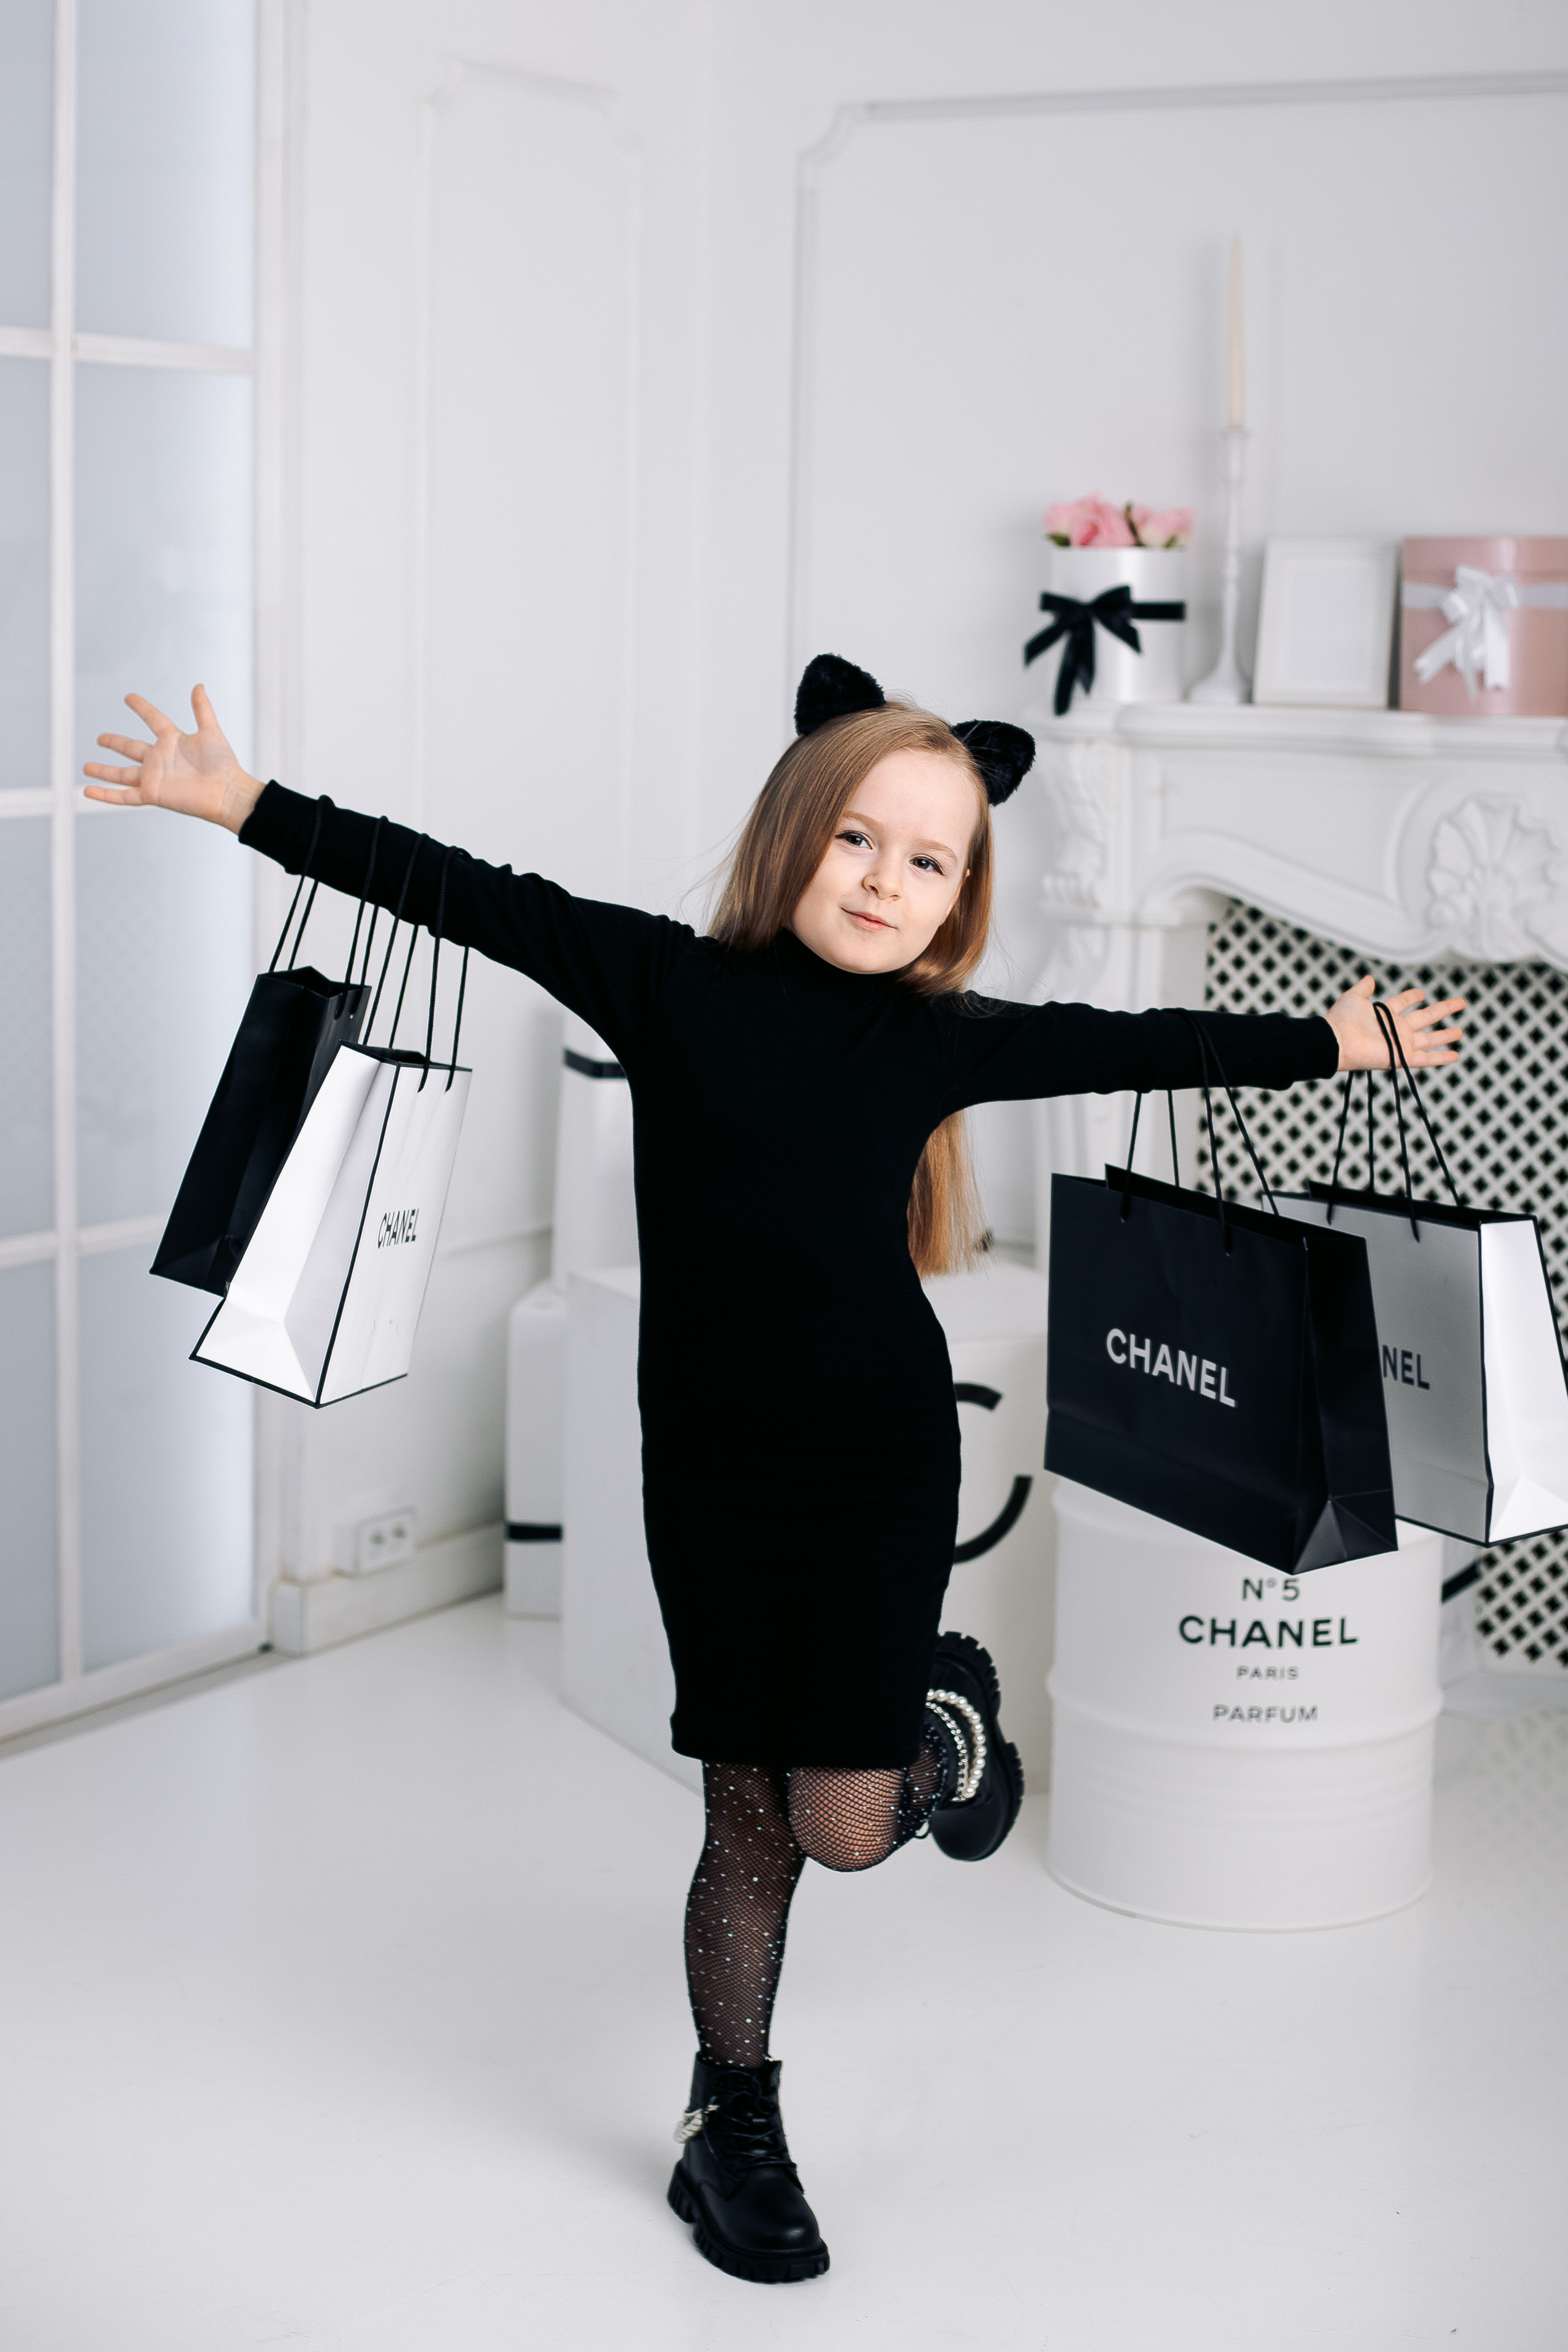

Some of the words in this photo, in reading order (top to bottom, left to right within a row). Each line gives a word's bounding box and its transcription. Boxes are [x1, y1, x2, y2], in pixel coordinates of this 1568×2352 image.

[377, 1208, 419, 1249] CHANEL
[1106, 1328, 1236, 1408] CHANEL
[1382, 1344, 1430, 1390] NEL
[1179, 1615, 1357, 1647] CHANEL
[1237, 1665, 1299, 1680] PARIS
[1213, 1704, 1317, 1723] PARFUM
